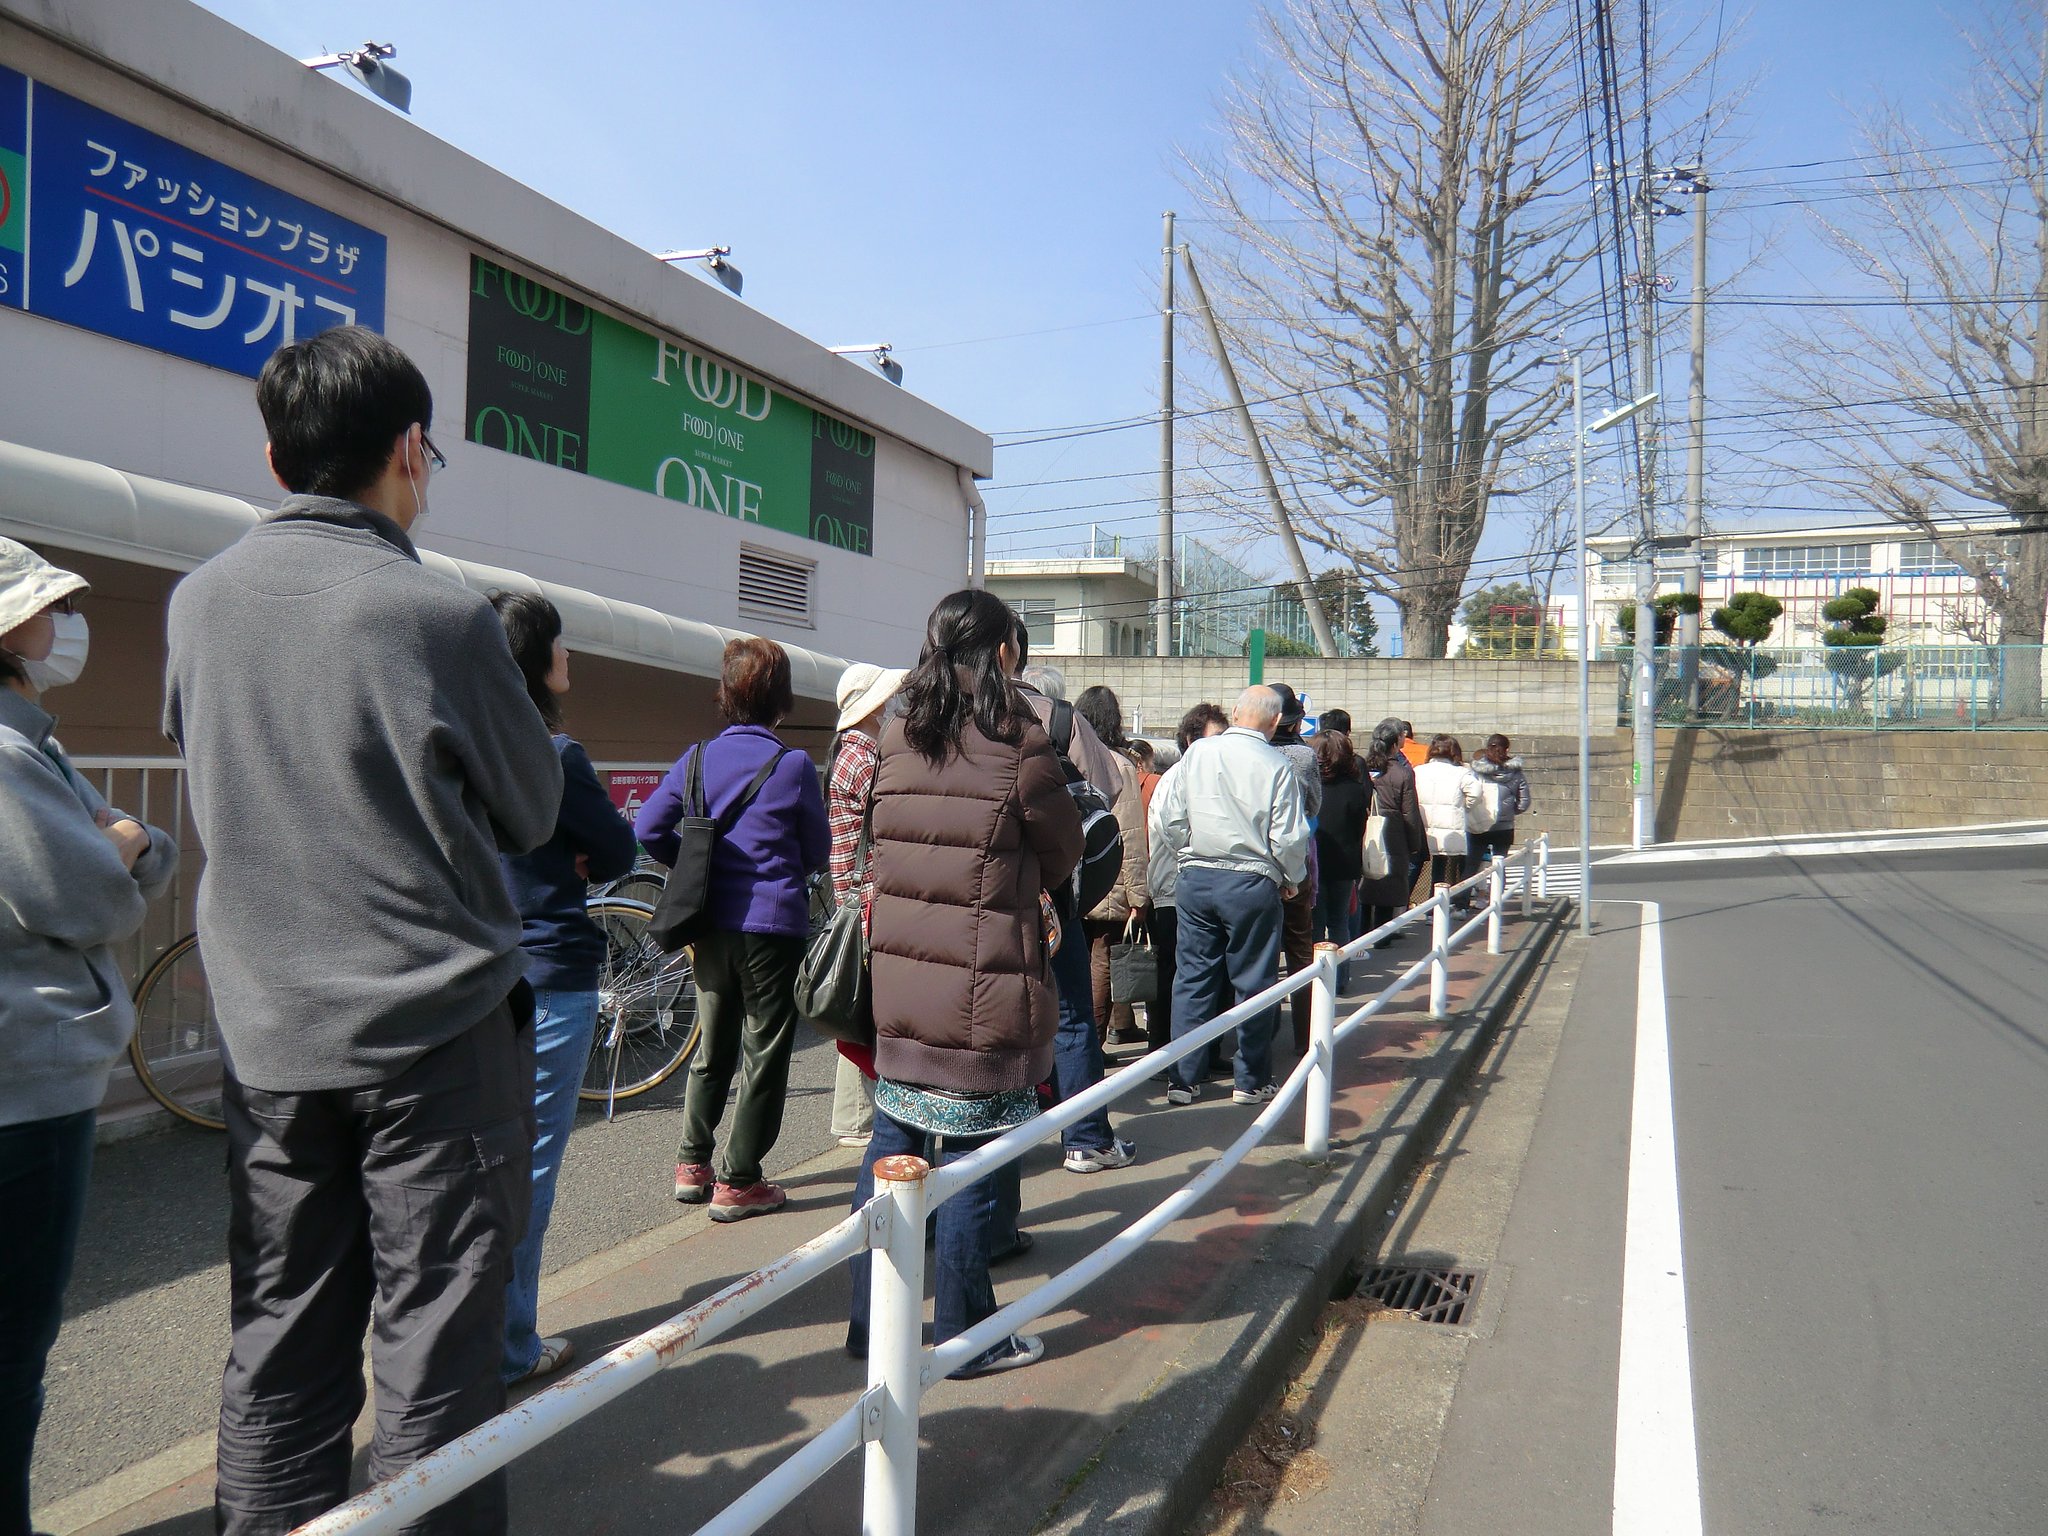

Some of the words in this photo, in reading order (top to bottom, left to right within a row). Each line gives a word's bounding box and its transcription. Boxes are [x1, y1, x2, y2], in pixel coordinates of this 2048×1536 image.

[86, 139, 360, 276] ファッションプラザ
[472, 257, 591, 336] FOOD
[497, 345, 532, 373] FOOD
[537, 361, 568, 387] ONE
[650, 339, 772, 422] FOOD
[683, 412, 714, 440] FOOD
[717, 426, 745, 452] ONE
[694, 449, 711, 461] SUPER
[712, 455, 733, 468] MARKET
